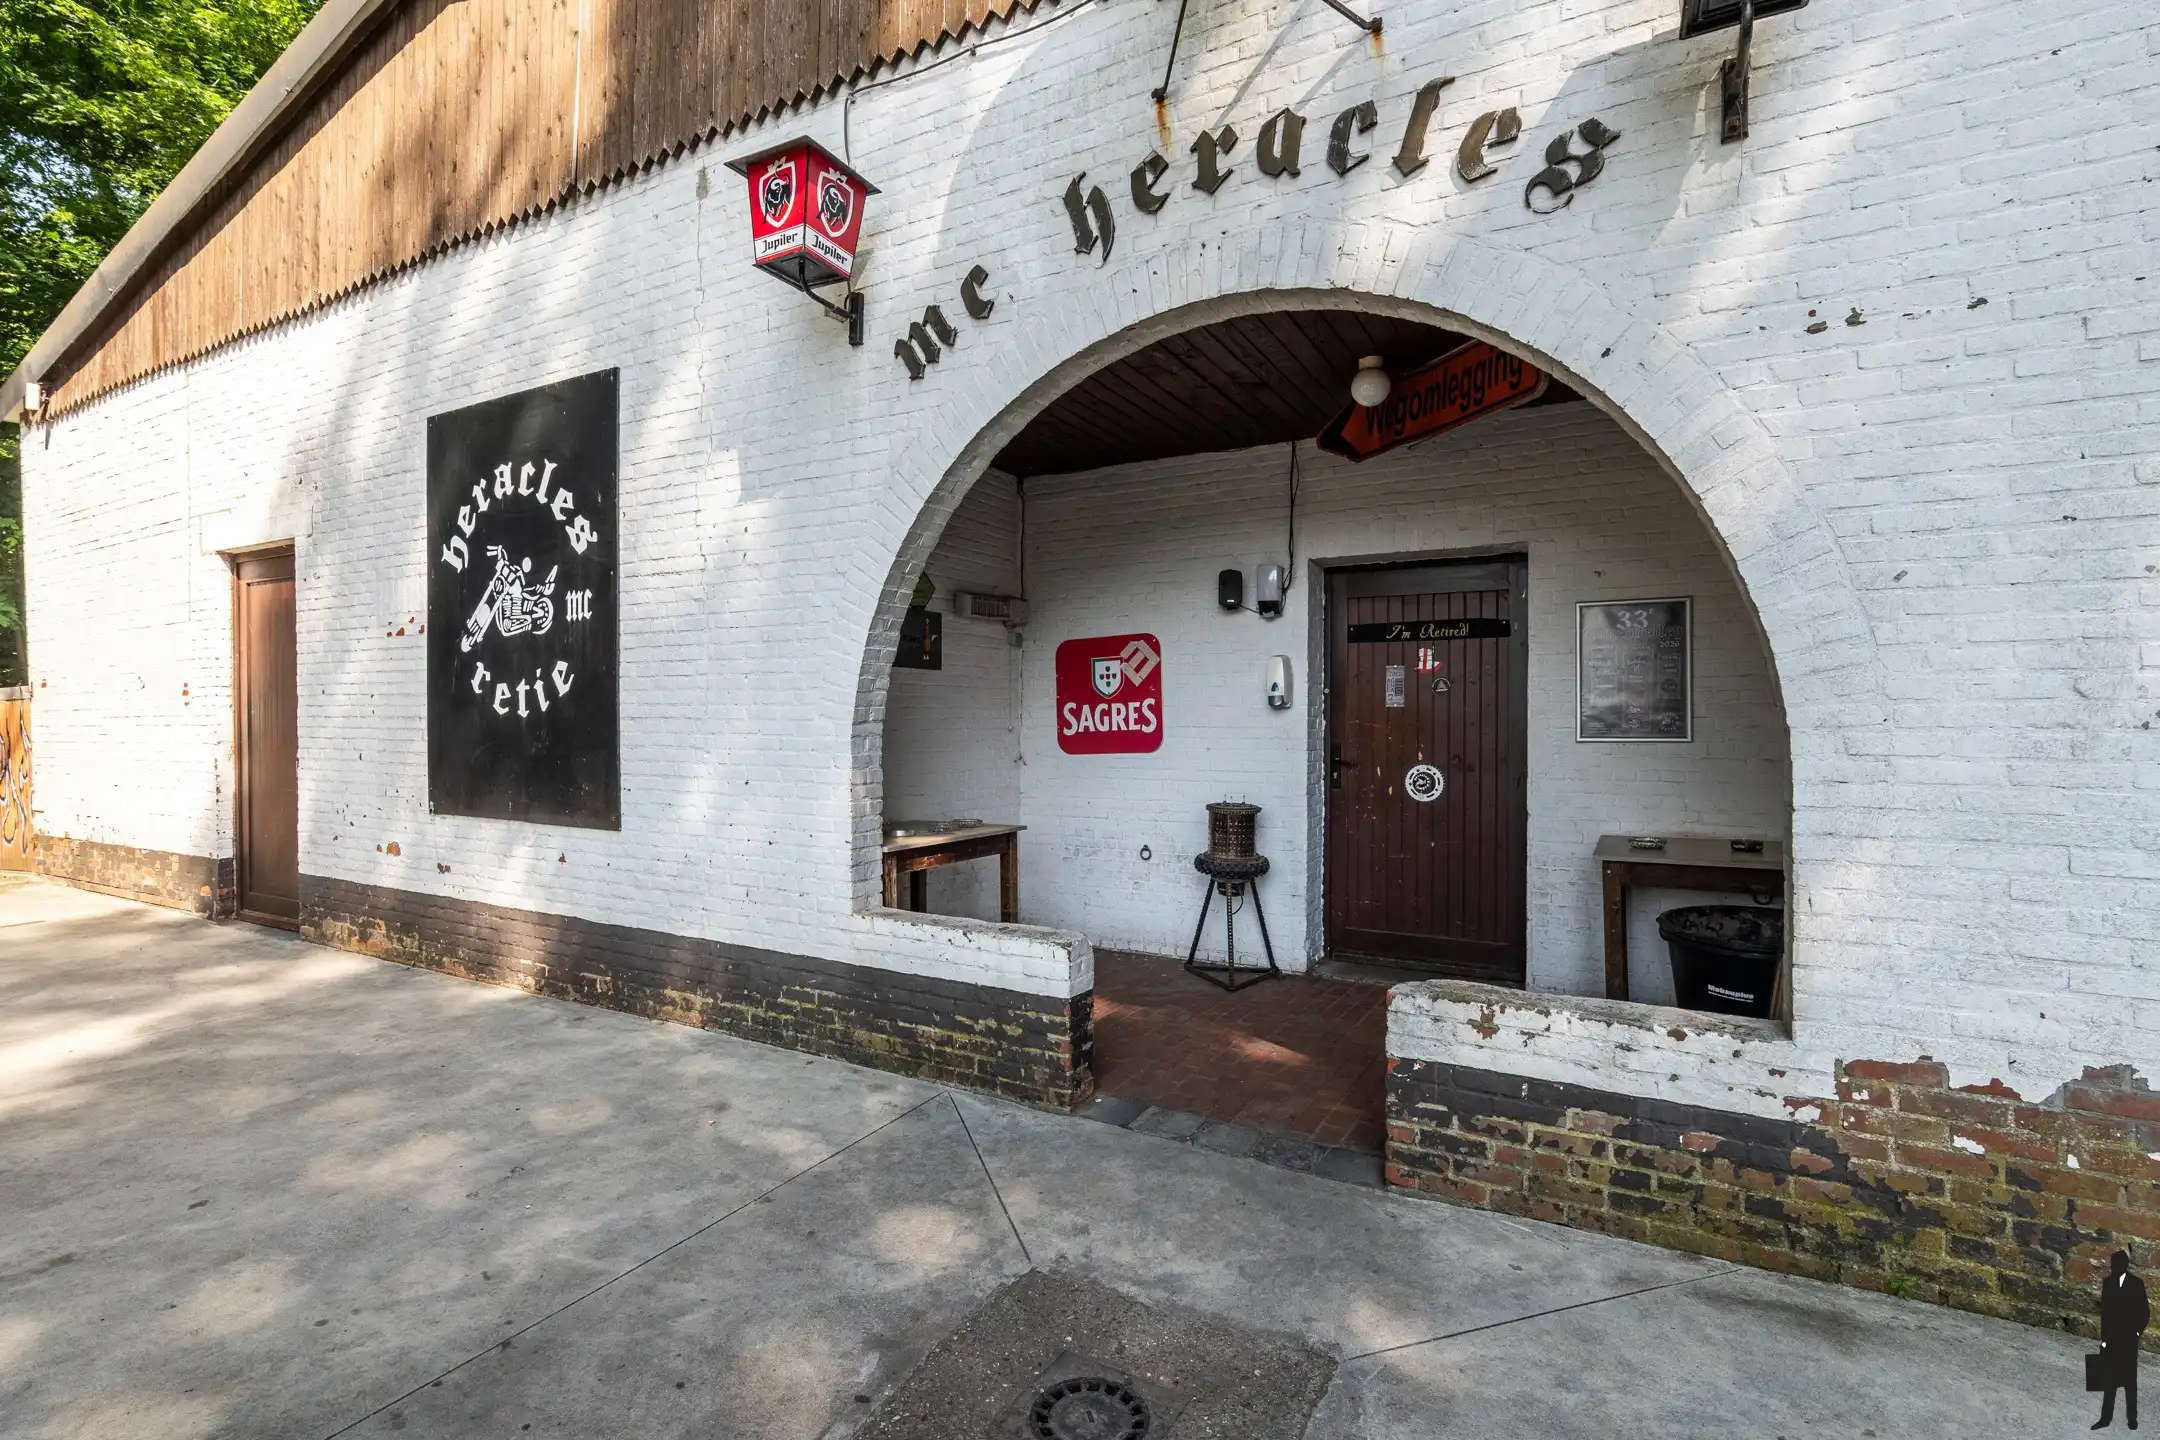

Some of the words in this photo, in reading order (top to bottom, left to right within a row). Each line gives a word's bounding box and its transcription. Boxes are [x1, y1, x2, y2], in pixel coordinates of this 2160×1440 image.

[761, 232, 798, 253] Jupiler
[811, 234, 848, 265] Jupiler
[894, 264, 996, 380] mc
[1365, 345, 1524, 437] Wegomlegging
[565, 587, 593, 622] mc
[1386, 625, 1412, 639] I'm
[1419, 622, 1469, 639] Retired!
[470, 659, 576, 718] retie
[1063, 697, 1157, 736] SAGRES
